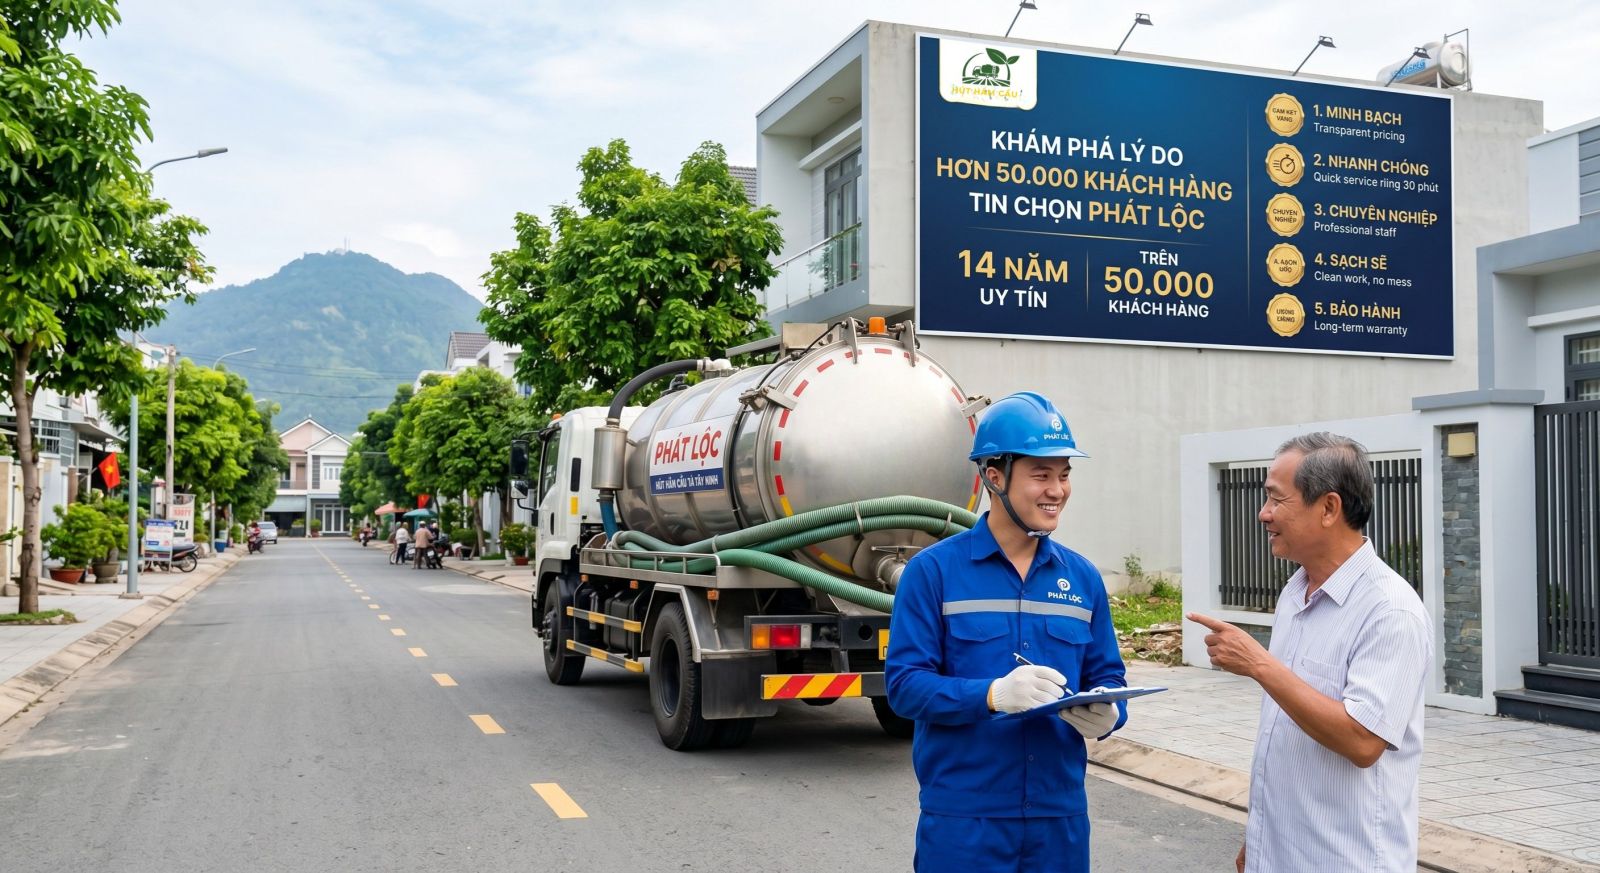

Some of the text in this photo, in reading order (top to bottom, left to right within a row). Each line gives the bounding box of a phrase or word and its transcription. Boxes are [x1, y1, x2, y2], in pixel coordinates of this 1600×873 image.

[1313, 104, 1402, 127] 1. MINH BẠCH
[1313, 122, 1405, 144] Transparent pricing
[991, 128, 1183, 166] KHÁM PHÁ LÝ DO
[1313, 153, 1429, 177] 2. NHANH CHÓNG
[936, 157, 1233, 201] HƠN 50.000 KHÁCH HÀNG
[1313, 171, 1341, 184] Quick
[1343, 175, 1378, 187] service
[1403, 180, 1416, 191] 30
[1417, 181, 1439, 193] phút
[969, 191, 1205, 233] TIN CHỌN PHÁT LỘC
[1314, 203, 1438, 228] 3. CHUYÊN NGHIỆP
[1314, 221, 1397, 238] Professional staff
[958, 249, 1068, 283] 14 NĂM
[1139, 249, 1178, 267] TRÊN
[1314, 252, 1388, 271] 4. SẠCH SẼ
[1104, 266, 1214, 299] 50.000
[1314, 271, 1412, 287] Clean work, no mess
[980, 286, 1048, 308] UY TÍN
[1108, 298, 1210, 318] KHÁCH HÀNG
[1314, 300, 1401, 320] 5. BẢO HÀNH
[1314, 320, 1408, 338] Long-term warranty
[654, 426, 722, 467] PHÁT LỘC
